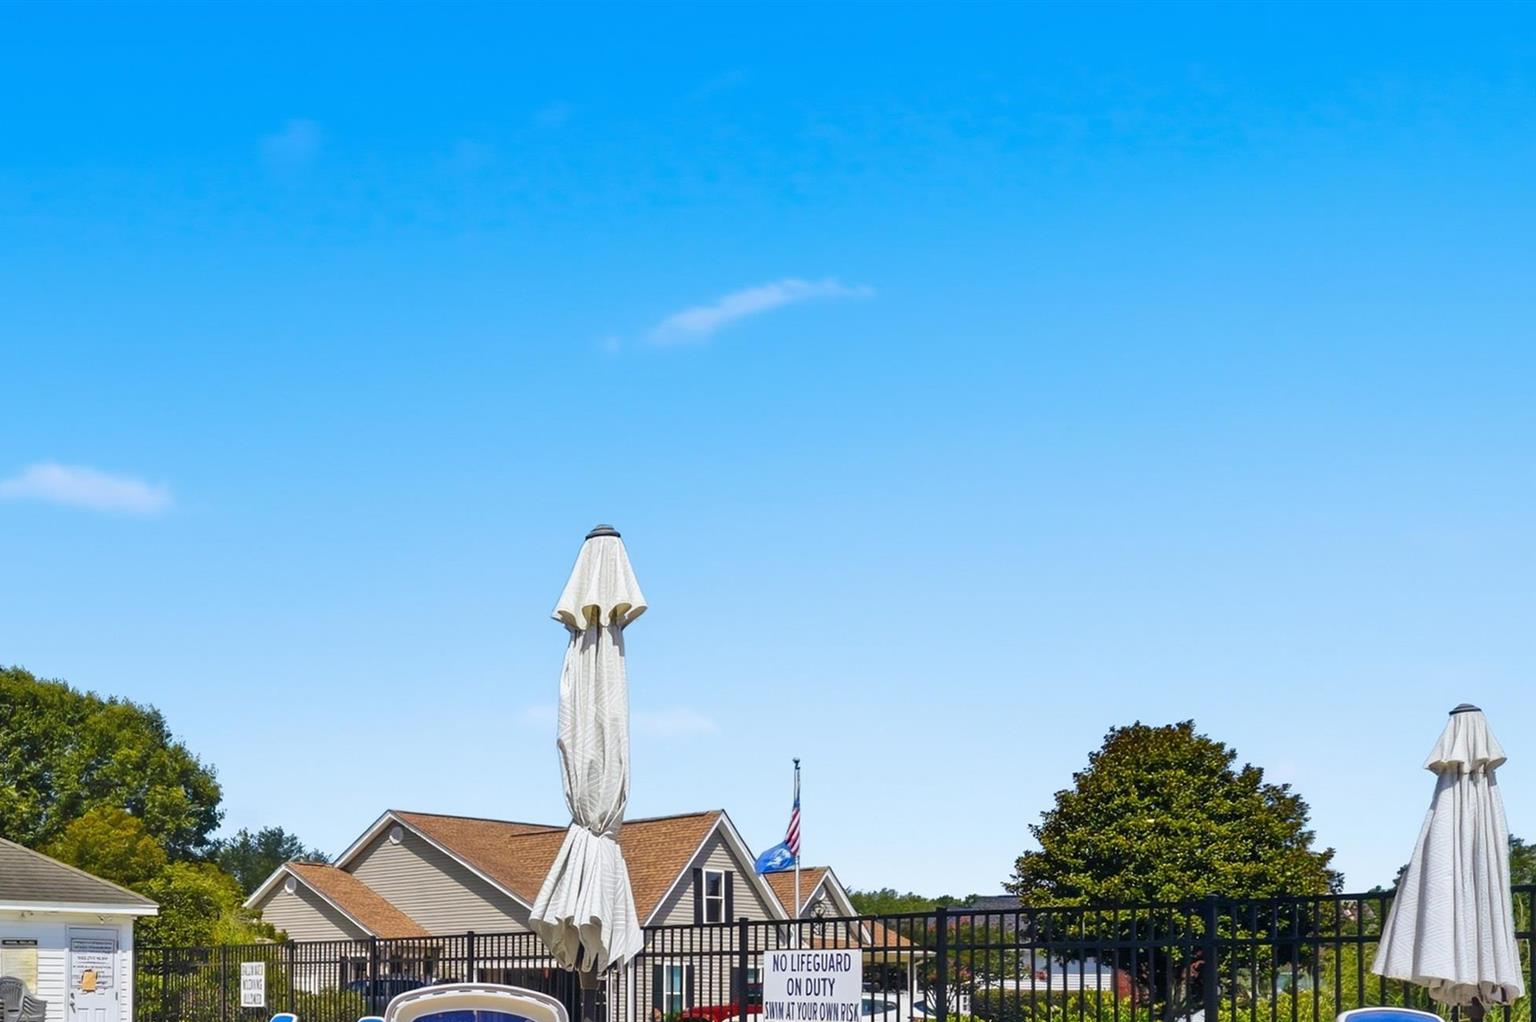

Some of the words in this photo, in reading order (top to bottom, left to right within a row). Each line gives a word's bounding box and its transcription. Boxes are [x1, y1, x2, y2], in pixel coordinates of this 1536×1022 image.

[772, 953, 788, 972] NO
[790, 953, 851, 972] LIFEGUARD
[786, 978, 802, 996] ON
[805, 978, 835, 997] DUTY
[765, 1001, 784, 1019] SWIM
[786, 1001, 795, 1020] AT
[797, 1002, 817, 1021] YOUR
[819, 1002, 838, 1021] OWN
[840, 1003, 859, 1022] RISK
